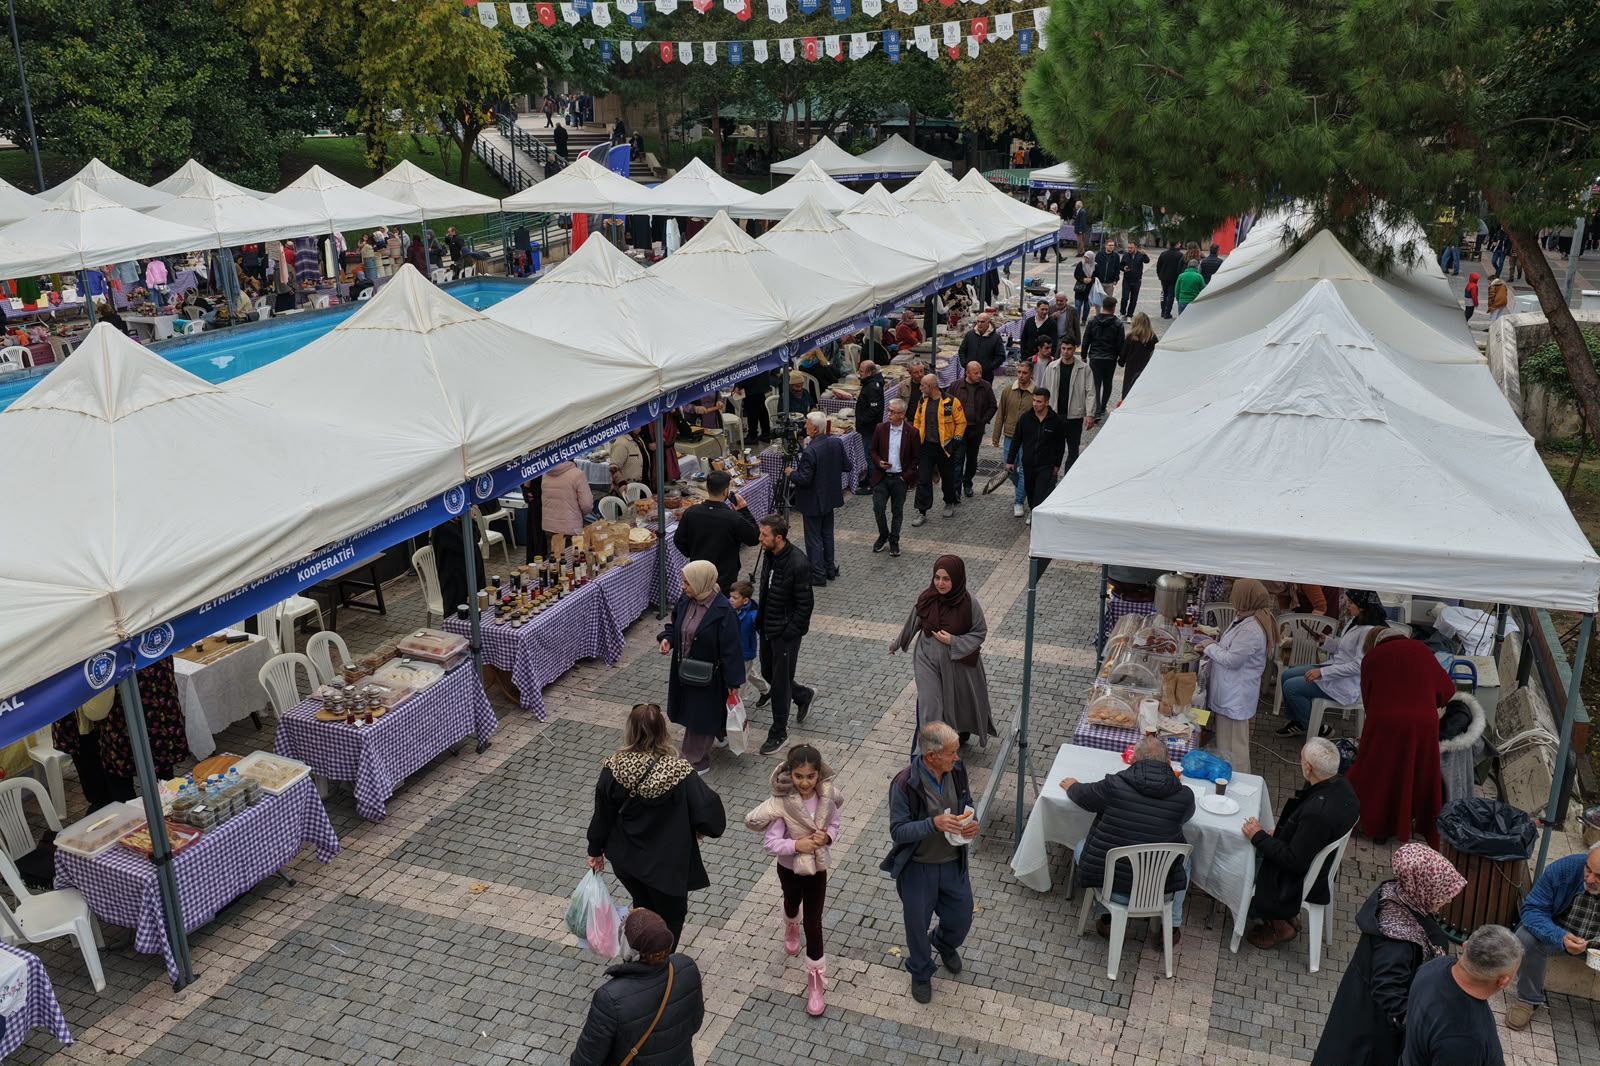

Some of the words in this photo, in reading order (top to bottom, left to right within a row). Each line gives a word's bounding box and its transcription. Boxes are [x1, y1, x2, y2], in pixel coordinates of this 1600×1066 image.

[521, 458, 550, 479] ÜRETİM
[549, 452, 560, 464] VE
[560, 439, 589, 461] İŞLETME
[588, 419, 630, 447] KOOPERATİFİ
[297, 544, 355, 583] KOOPERATİFİ
